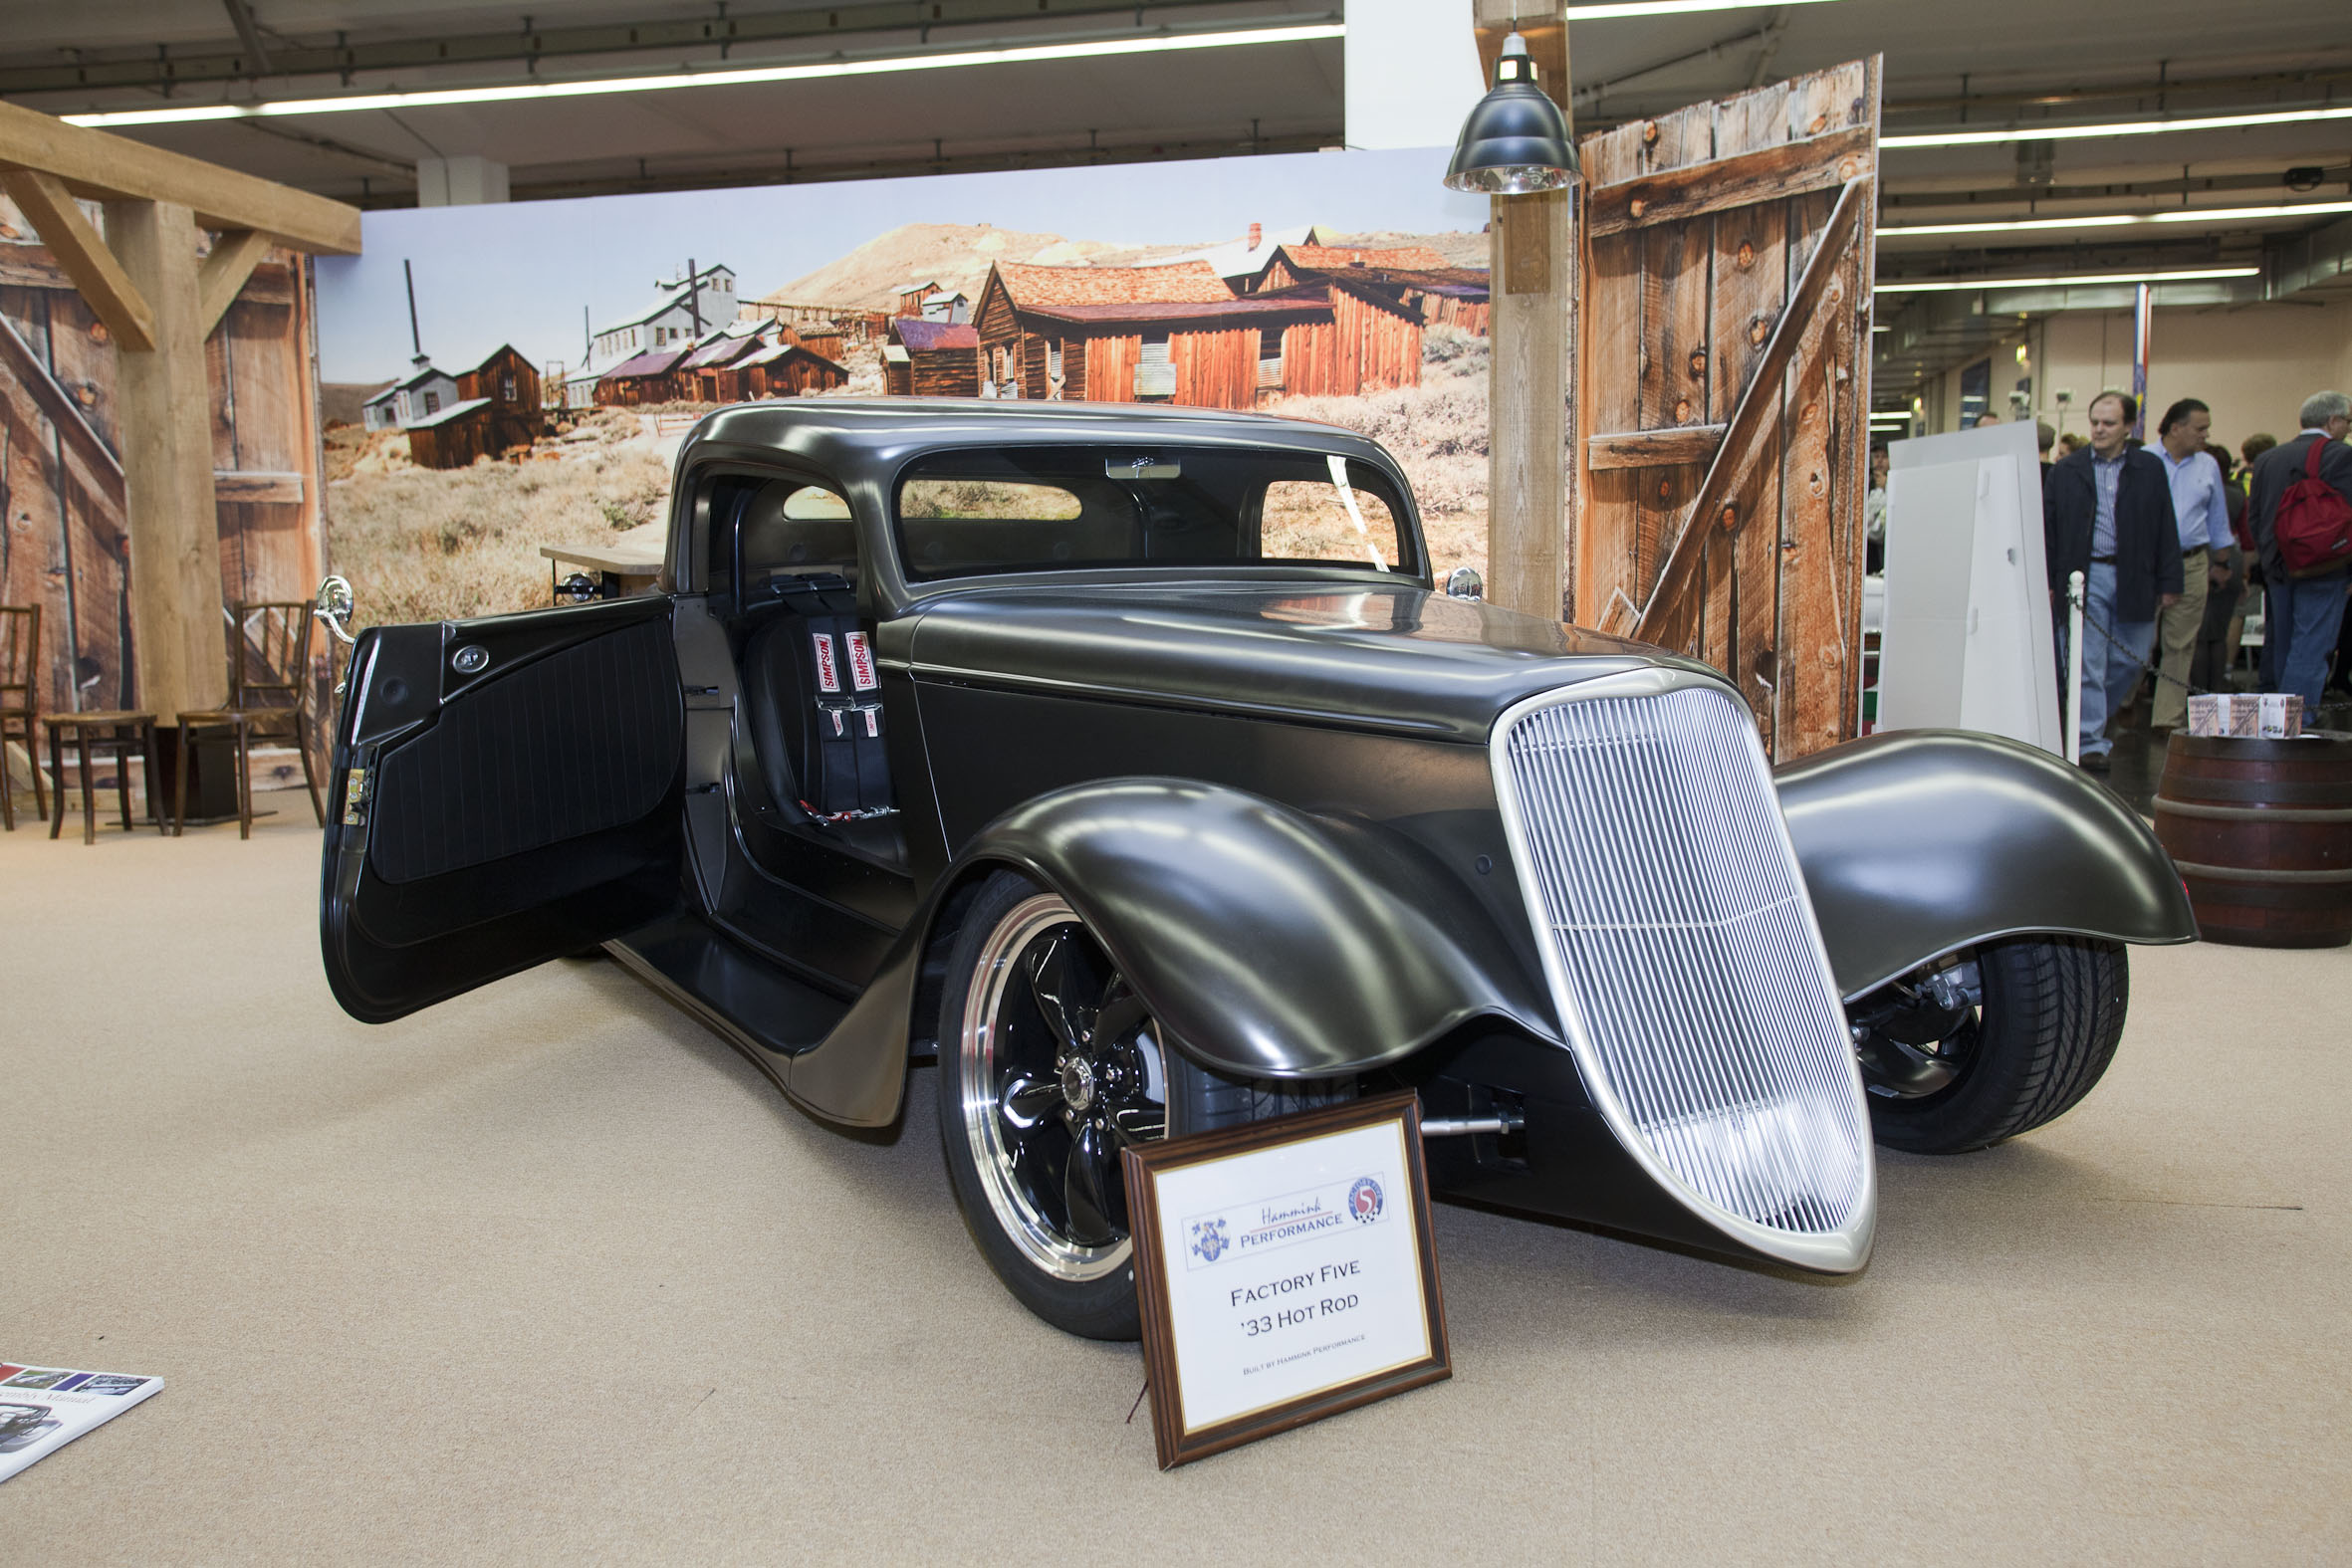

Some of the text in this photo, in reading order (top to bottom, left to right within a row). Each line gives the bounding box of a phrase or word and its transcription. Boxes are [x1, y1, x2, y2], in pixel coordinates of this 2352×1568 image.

[820, 640, 834, 687] SIMPSON
[852, 637, 871, 685] SIMPSON
[1241, 1214, 1343, 1248] PERFORMANCE
[1262, 1196, 1322, 1225] Hammink
[1231, 1260, 1361, 1307] FACTORY FIVE
[1241, 1294, 1359, 1337] '33 HOT ROD
